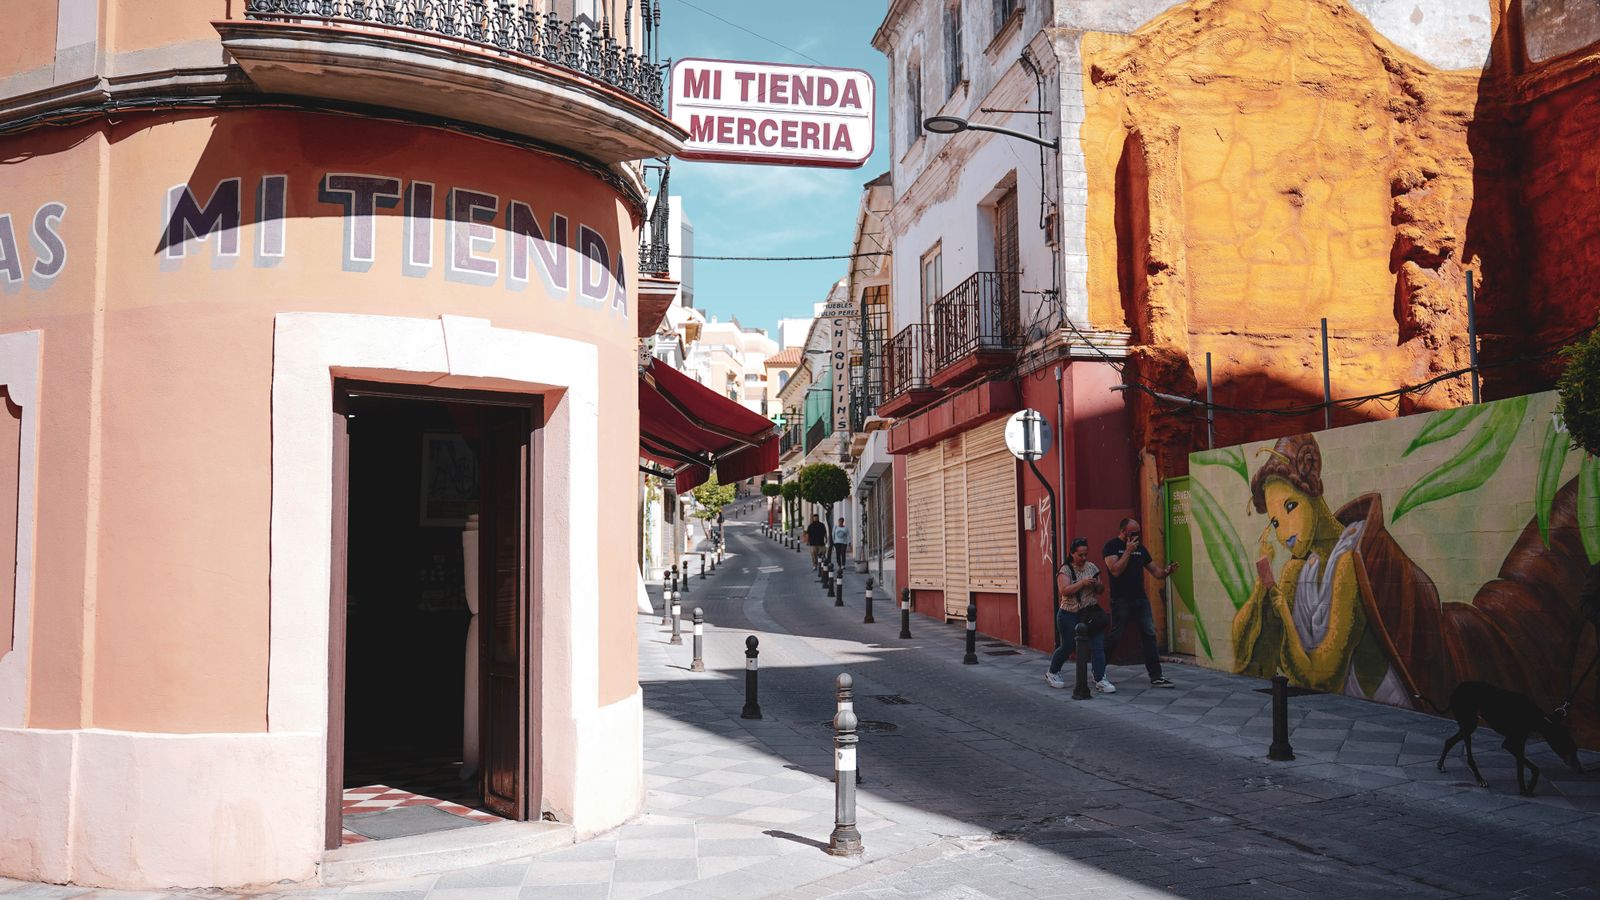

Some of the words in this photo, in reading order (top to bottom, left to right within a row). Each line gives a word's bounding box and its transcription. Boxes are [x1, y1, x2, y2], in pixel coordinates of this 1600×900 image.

[683, 68, 722, 100] MI
[734, 71, 862, 109] TIENDA
[689, 114, 853, 152] MERCERIA
[163, 173, 288, 260] MI
[322, 172, 628, 320] TIENDA
